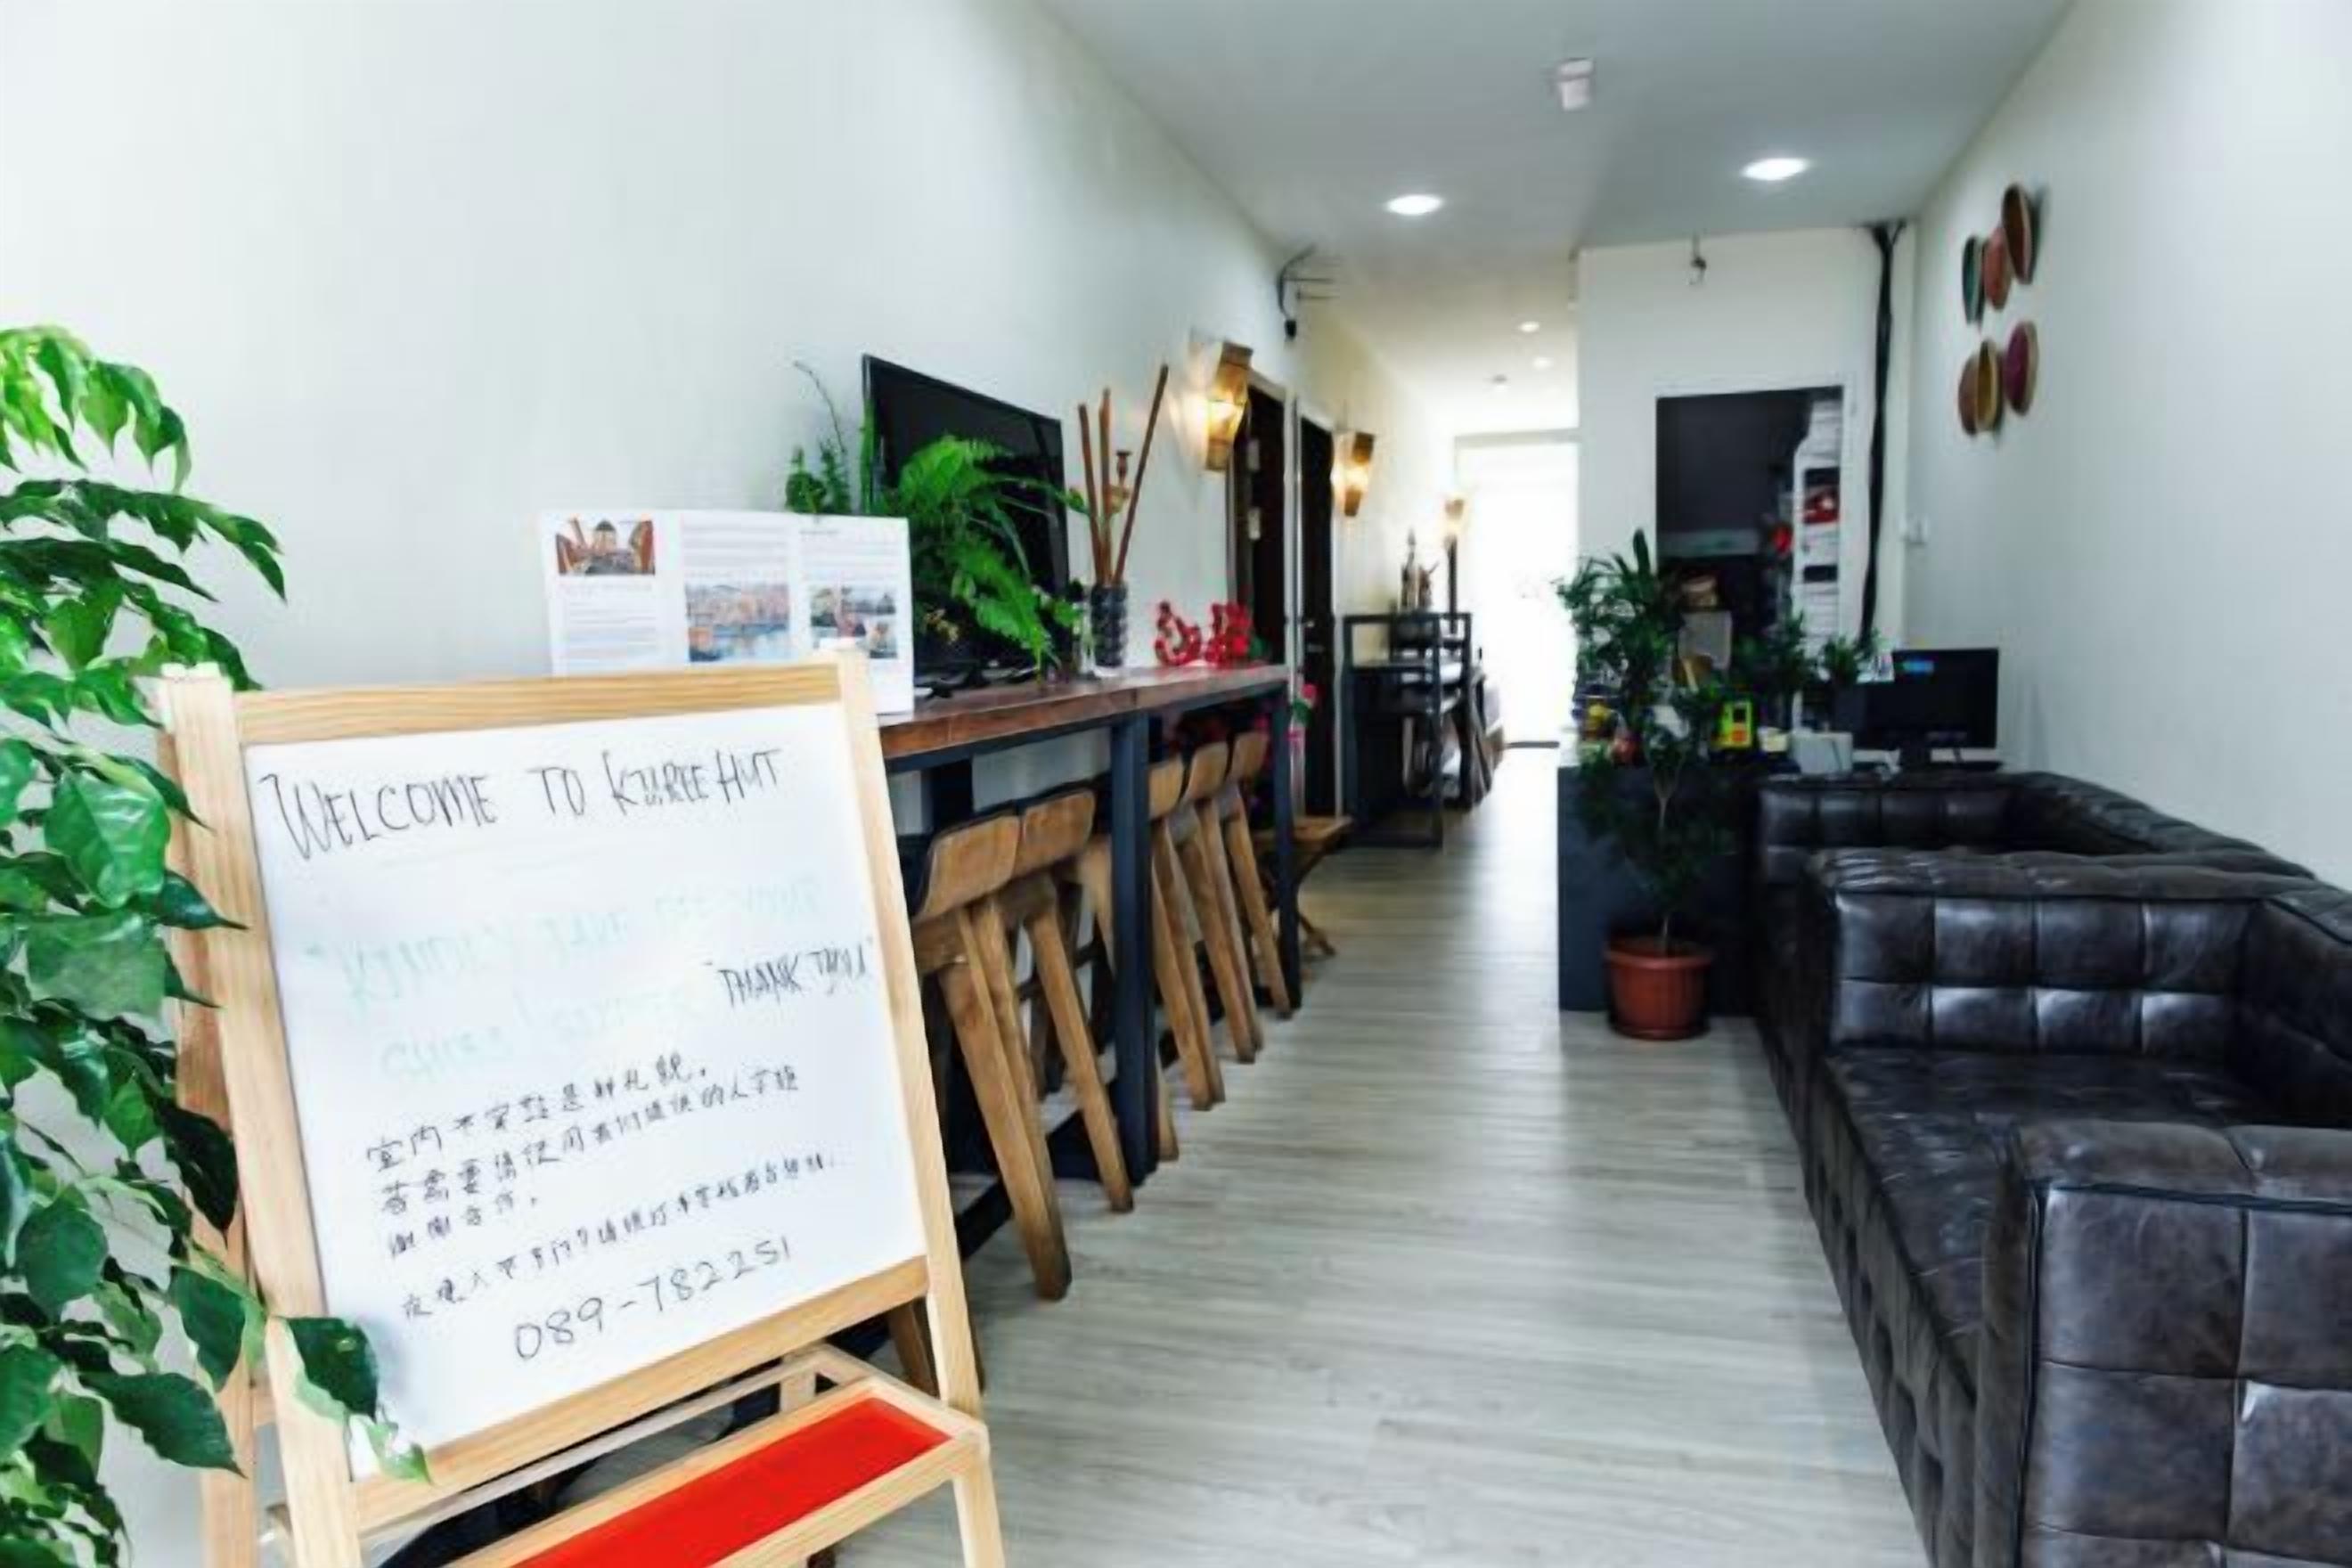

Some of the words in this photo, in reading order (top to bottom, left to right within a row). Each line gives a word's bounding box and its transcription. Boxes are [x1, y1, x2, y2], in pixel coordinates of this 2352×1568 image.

[259, 772, 497, 861] WELCOME
[528, 766, 585, 816] TO
[515, 1235, 791, 1361] 089-782251
